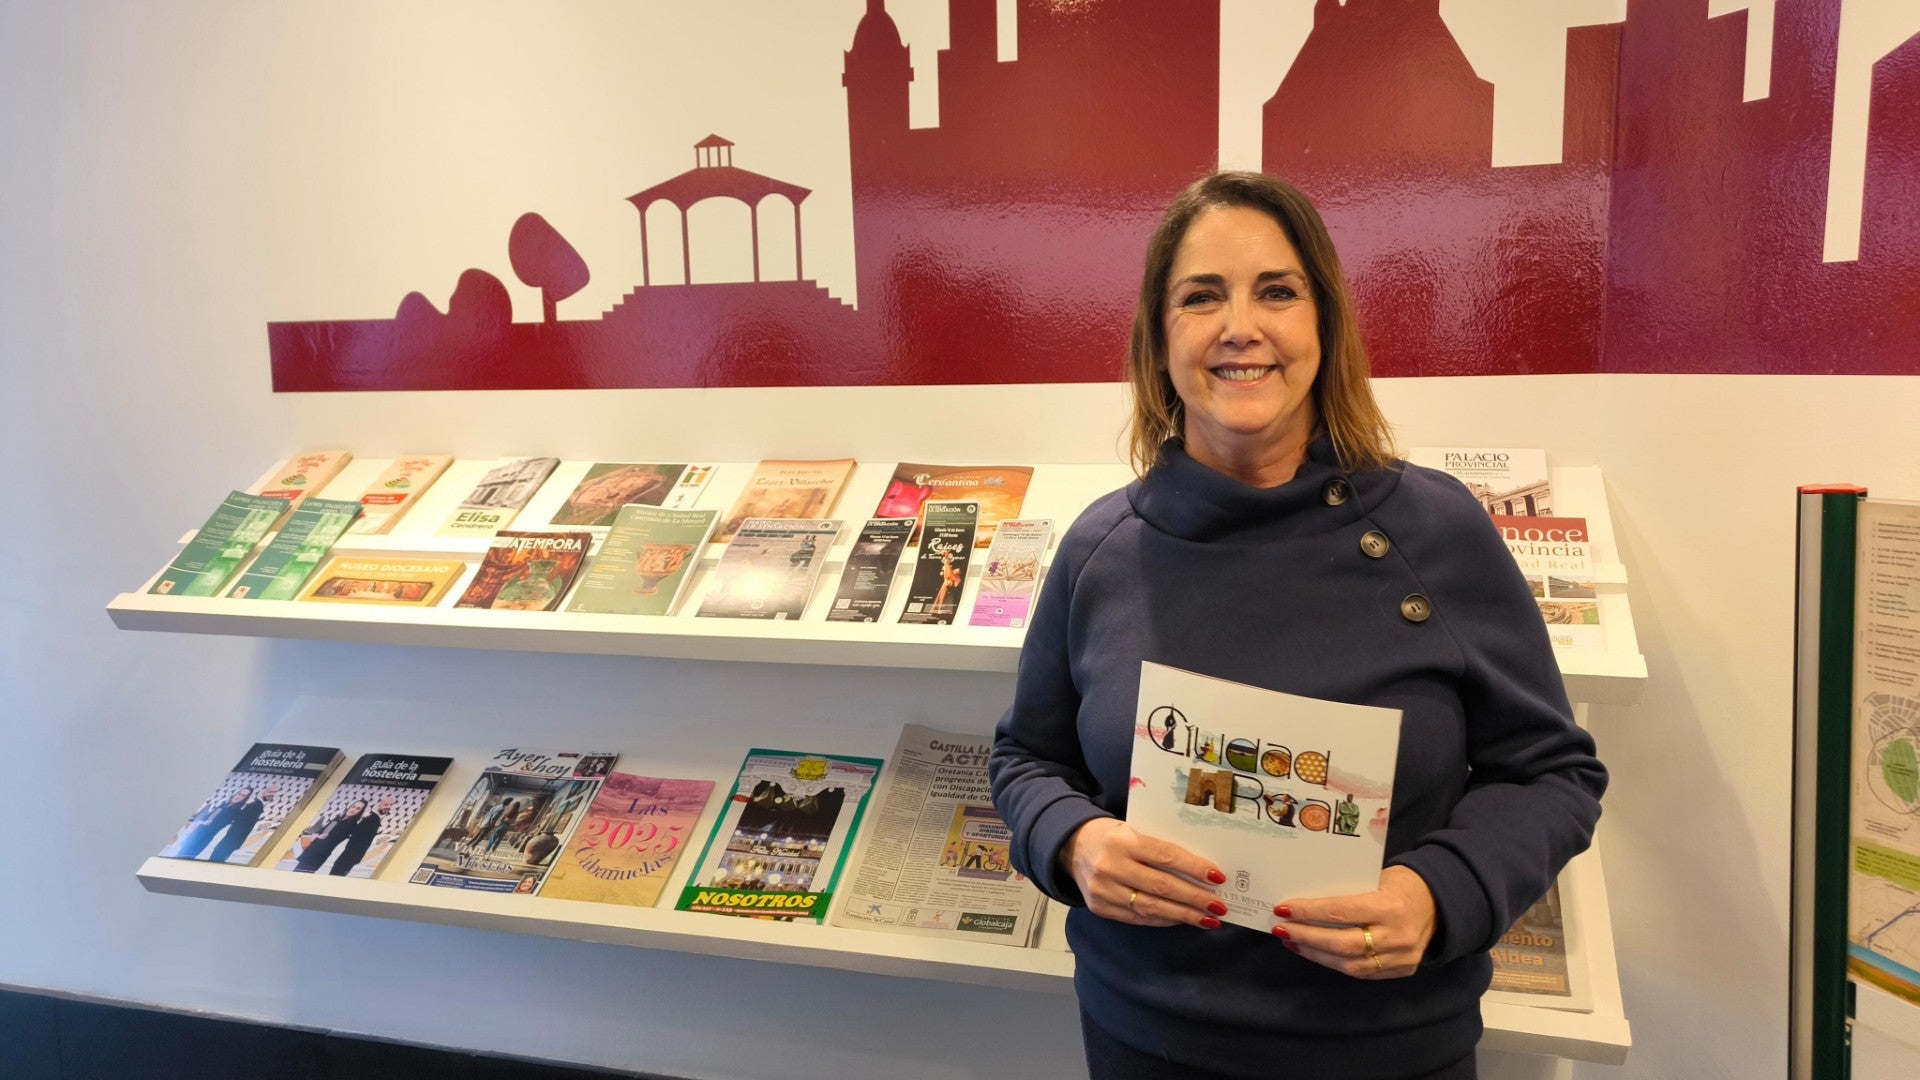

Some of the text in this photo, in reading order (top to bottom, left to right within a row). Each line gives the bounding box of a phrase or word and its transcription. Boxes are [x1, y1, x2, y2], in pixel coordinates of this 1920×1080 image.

[1446, 453, 1510, 461] PALACIO
[913, 472, 980, 488] Cervantina
[456, 512, 500, 522] Elisa
[1500, 526, 1583, 542] noce
[509, 538, 582, 552] ATEMPORA
[1511, 543, 1585, 556] vincia
[338, 562, 450, 574] MUSEO DIOCESANO
[1548, 561, 1584, 569] Real
[930, 740, 974, 754] CASTILLA
[1148, 702, 1331, 787] Ciudad
[260, 749, 306, 759] guía de la
[493, 748, 548, 768] Ayer
[250, 757, 304, 768] hostelería
[370, 760, 419, 771] guía de la
[362, 768, 418, 780] hostelería
[938, 768, 973, 776] Oretania
[930, 790, 966, 800] Igualdad
[626, 799, 670, 816] Las
[1230, 773, 1361, 838] Real
[579, 818, 684, 854] 2025
[575, 846, 673, 880] Cabañuelas
[692, 892, 817, 908] NOSOTROS
[974, 919, 1013, 929] Globalcaja
[1502, 933, 1553, 946] iento
[1490, 948, 1544, 967] Aldea
